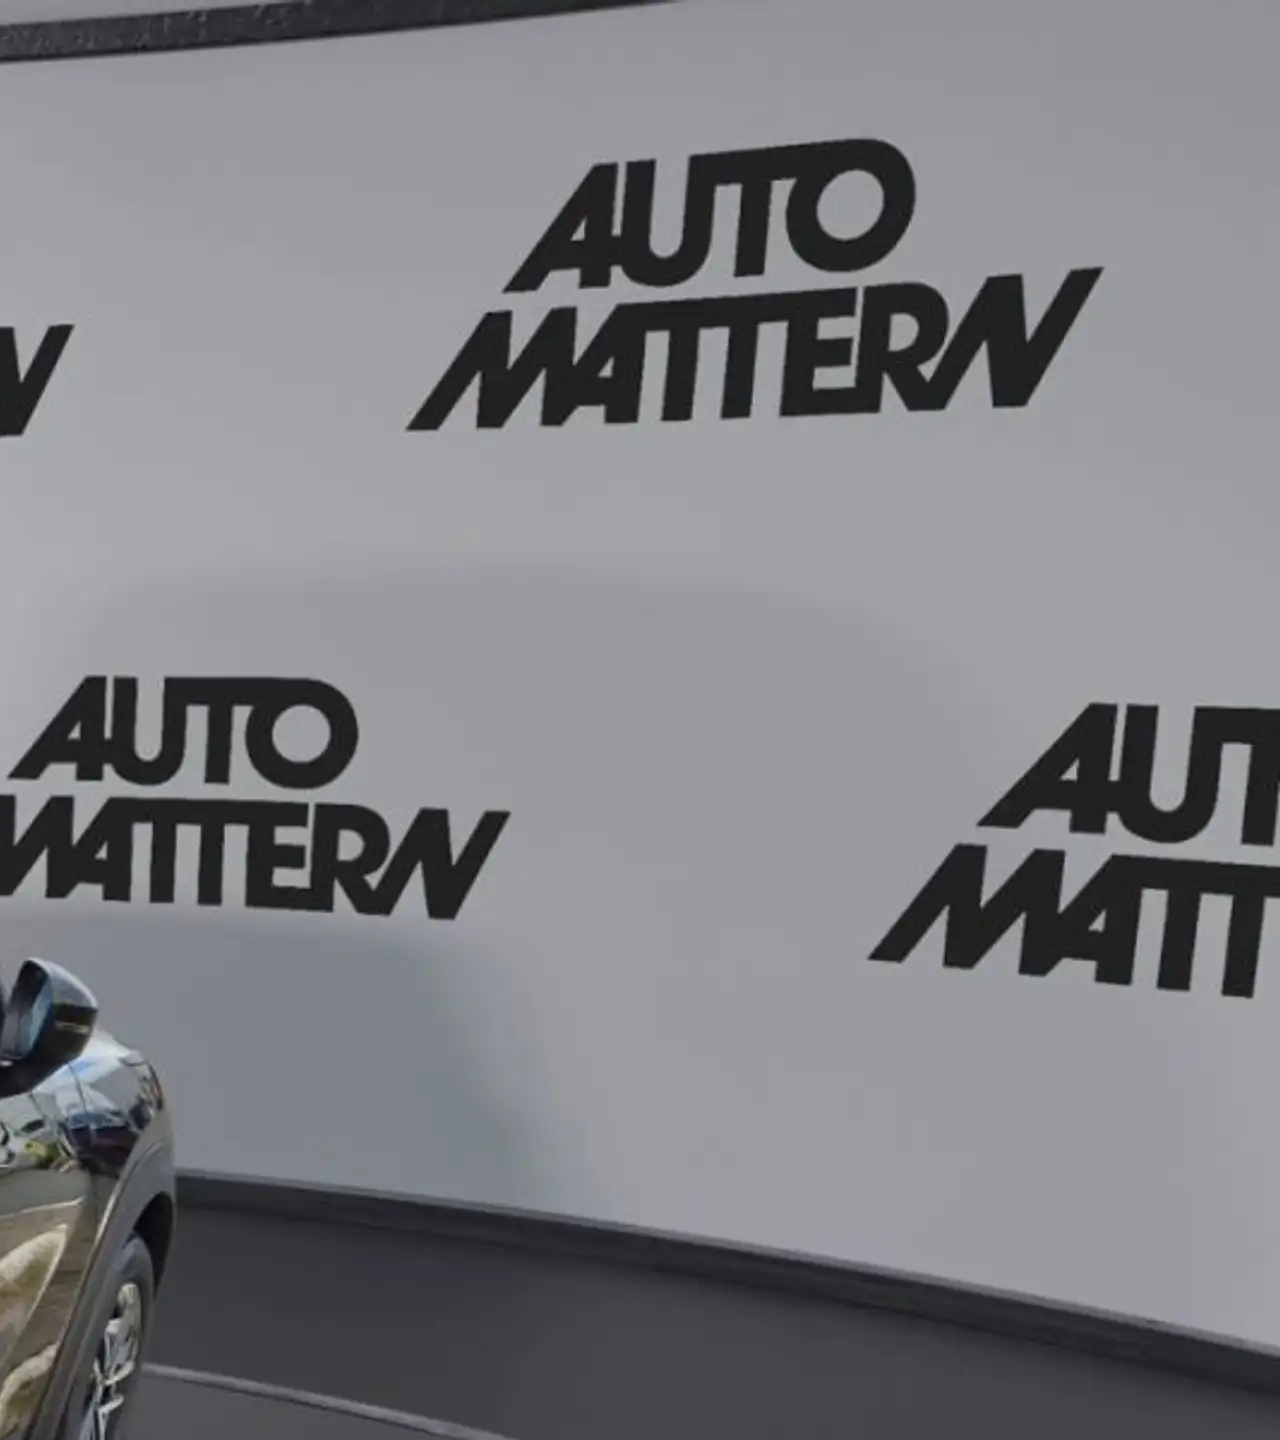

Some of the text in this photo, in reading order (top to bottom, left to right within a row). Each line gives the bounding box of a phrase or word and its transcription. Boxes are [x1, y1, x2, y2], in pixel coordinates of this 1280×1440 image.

[504, 140, 915, 292] AUTO
[408, 268, 1102, 430] MATTERN
[8, 676, 358, 790] AUTO
[977, 703, 1280, 845] AUT
[868, 843, 1280, 999] MATT
